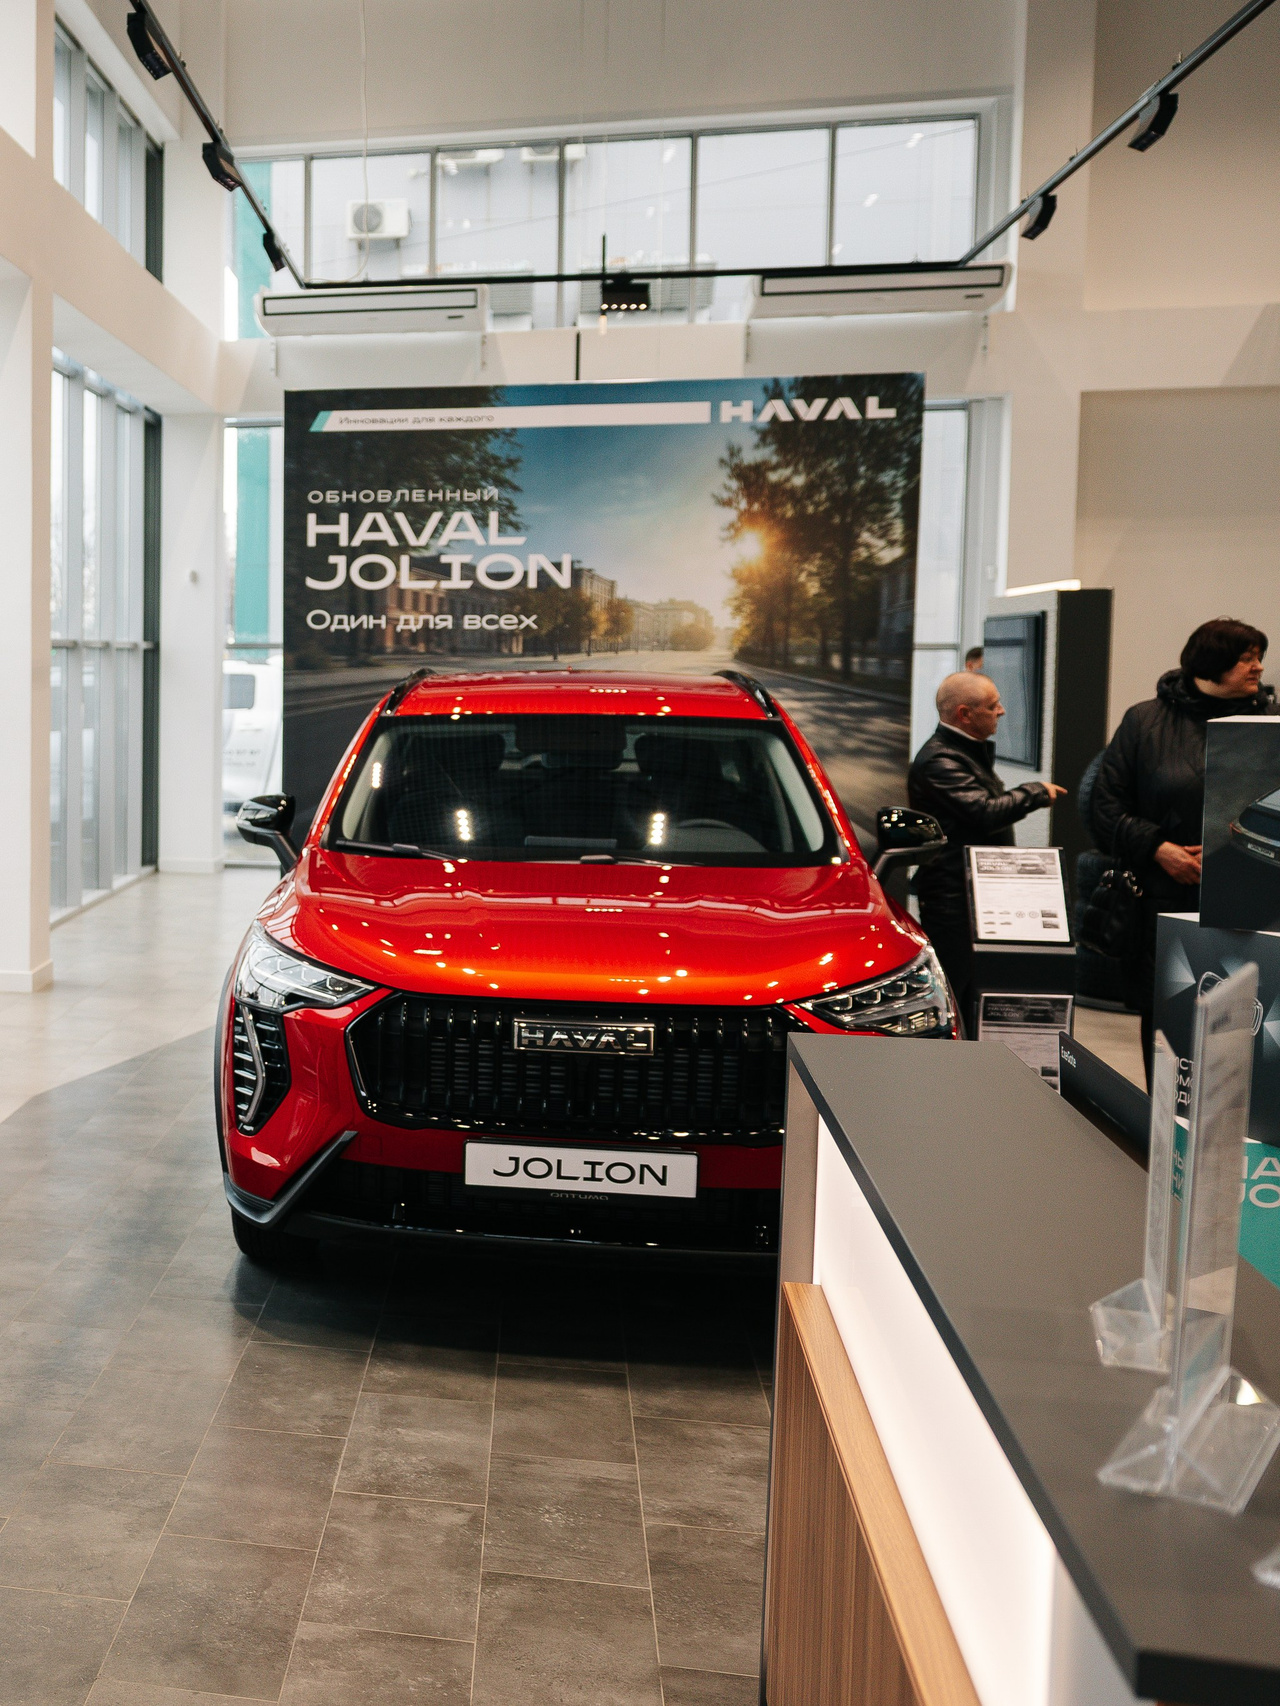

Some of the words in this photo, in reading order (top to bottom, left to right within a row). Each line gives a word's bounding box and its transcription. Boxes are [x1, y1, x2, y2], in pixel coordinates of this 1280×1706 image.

[339, 416, 409, 425] Инновации
[412, 416, 436, 425] для
[439, 414, 495, 423] каждого
[720, 396, 897, 424] HAVAL
[307, 485, 499, 504] ОБНОВЛЕННЫЙ
[306, 510, 528, 547] HAVAL
[305, 553, 572, 591] JOLION
[306, 609, 386, 632] Один
[396, 614, 453, 632] для
[463, 614, 539, 630] всех
[521, 1028, 648, 1050] HAVAL
[492, 1156, 668, 1186] JOLION
